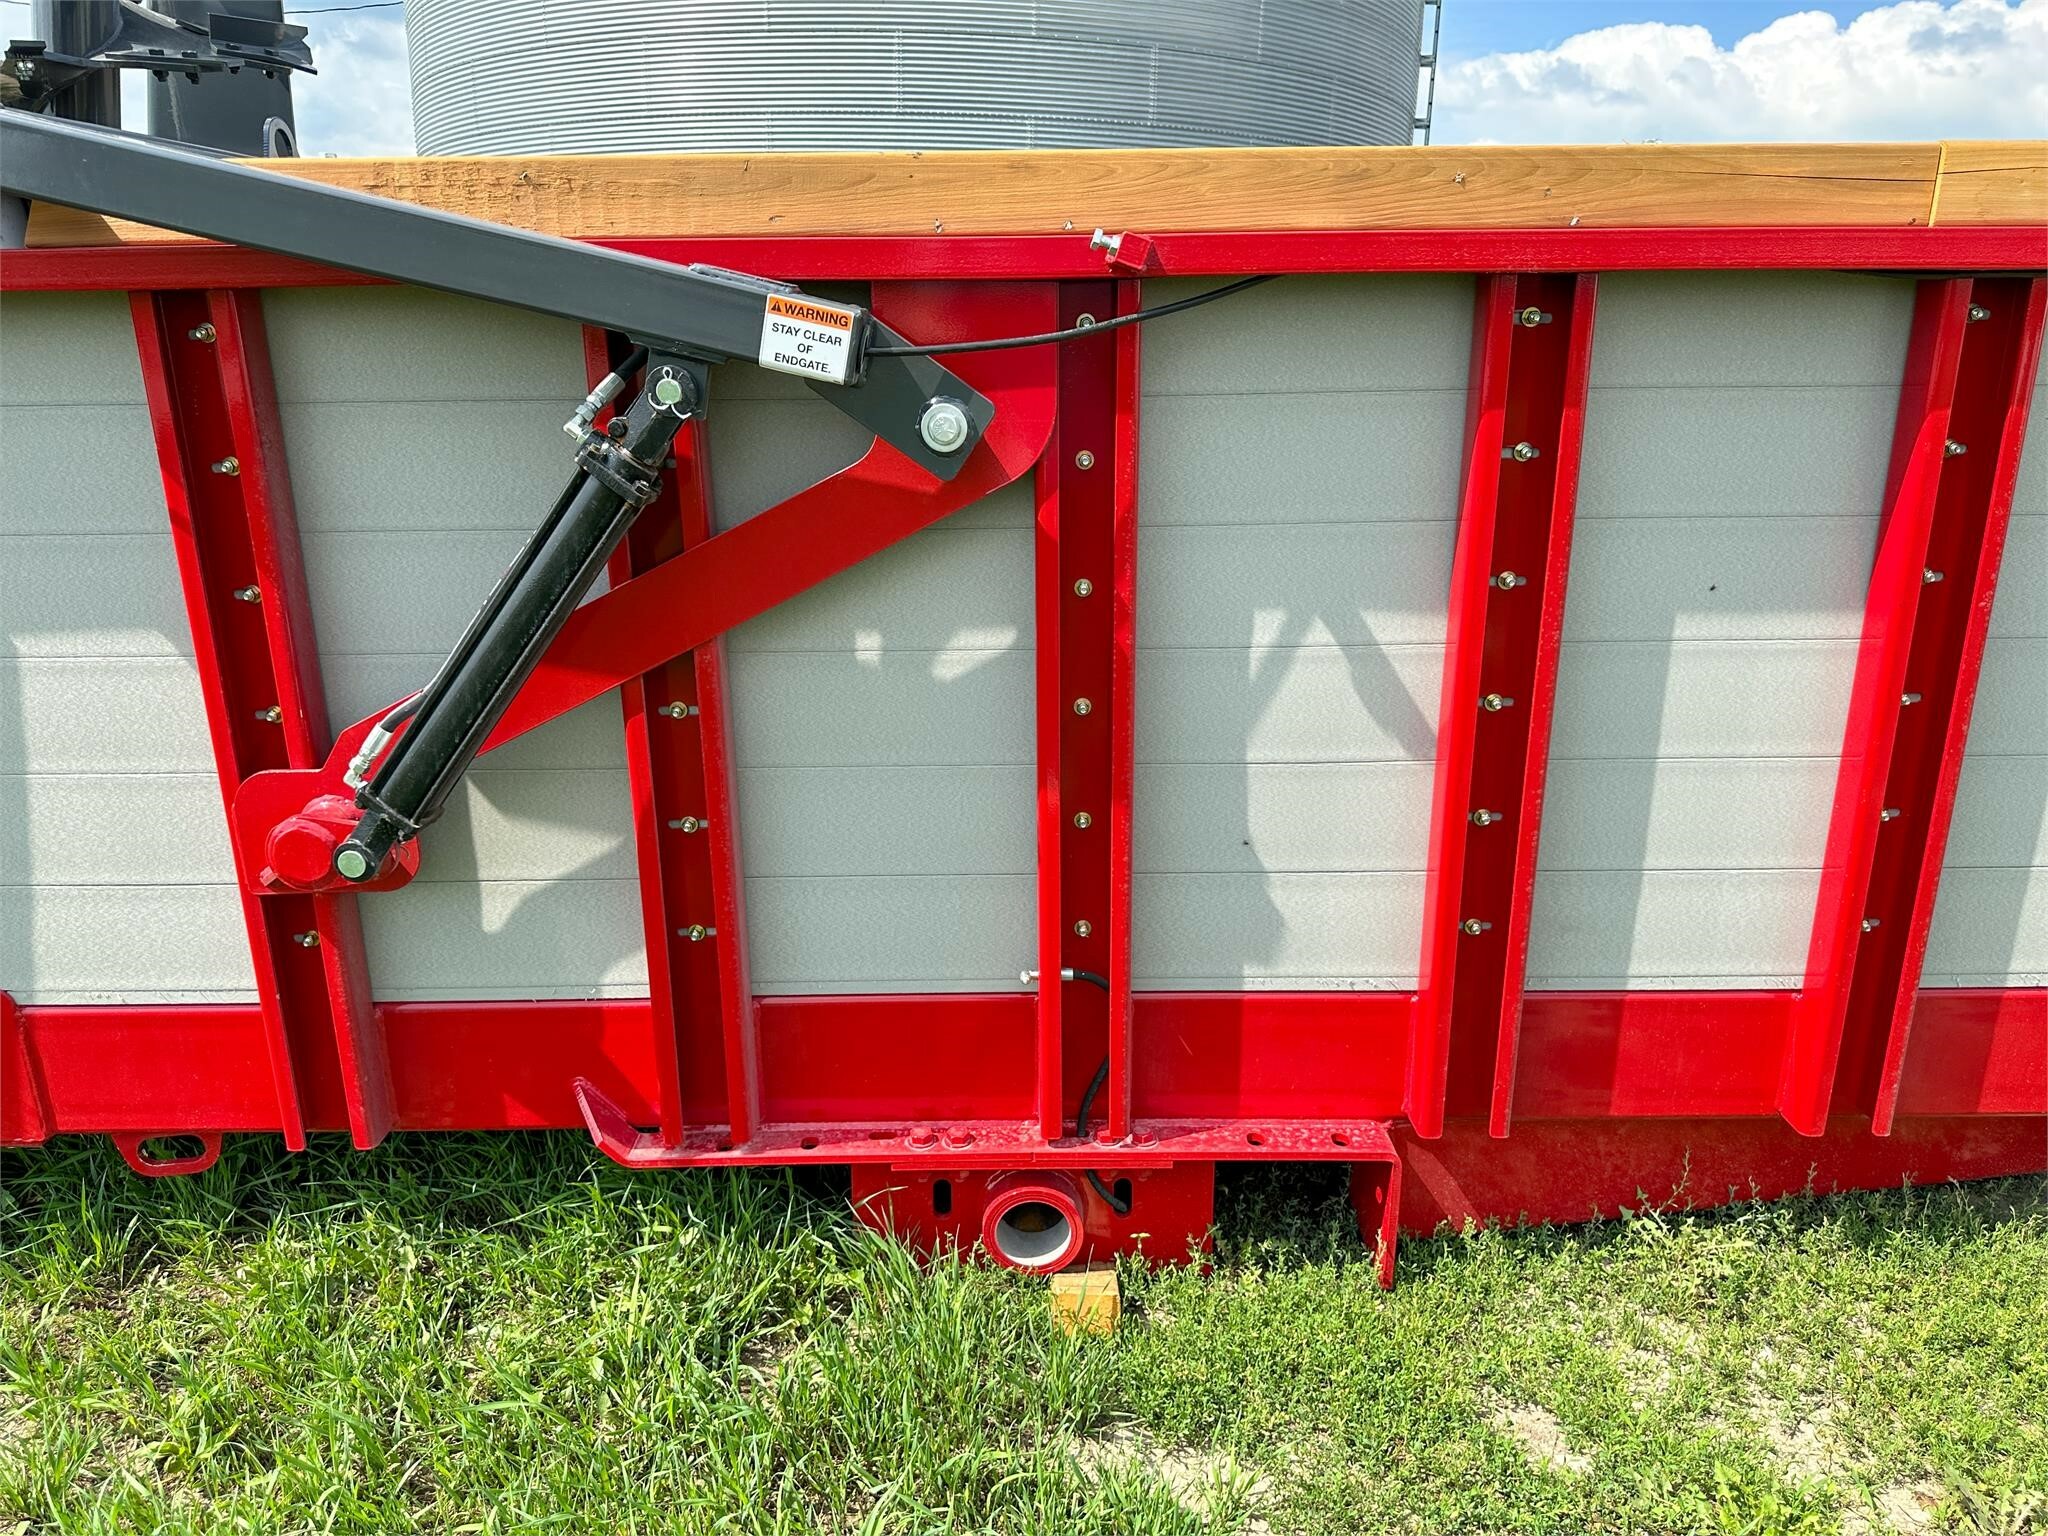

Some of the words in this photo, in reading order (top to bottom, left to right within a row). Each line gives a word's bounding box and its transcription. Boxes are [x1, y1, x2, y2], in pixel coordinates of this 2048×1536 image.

[784, 302, 849, 327] WARNING
[772, 322, 801, 337] STAY
[803, 329, 842, 347] CLEAR
[797, 343, 814, 354] OF
[774, 352, 831, 374] ENDGATE.
